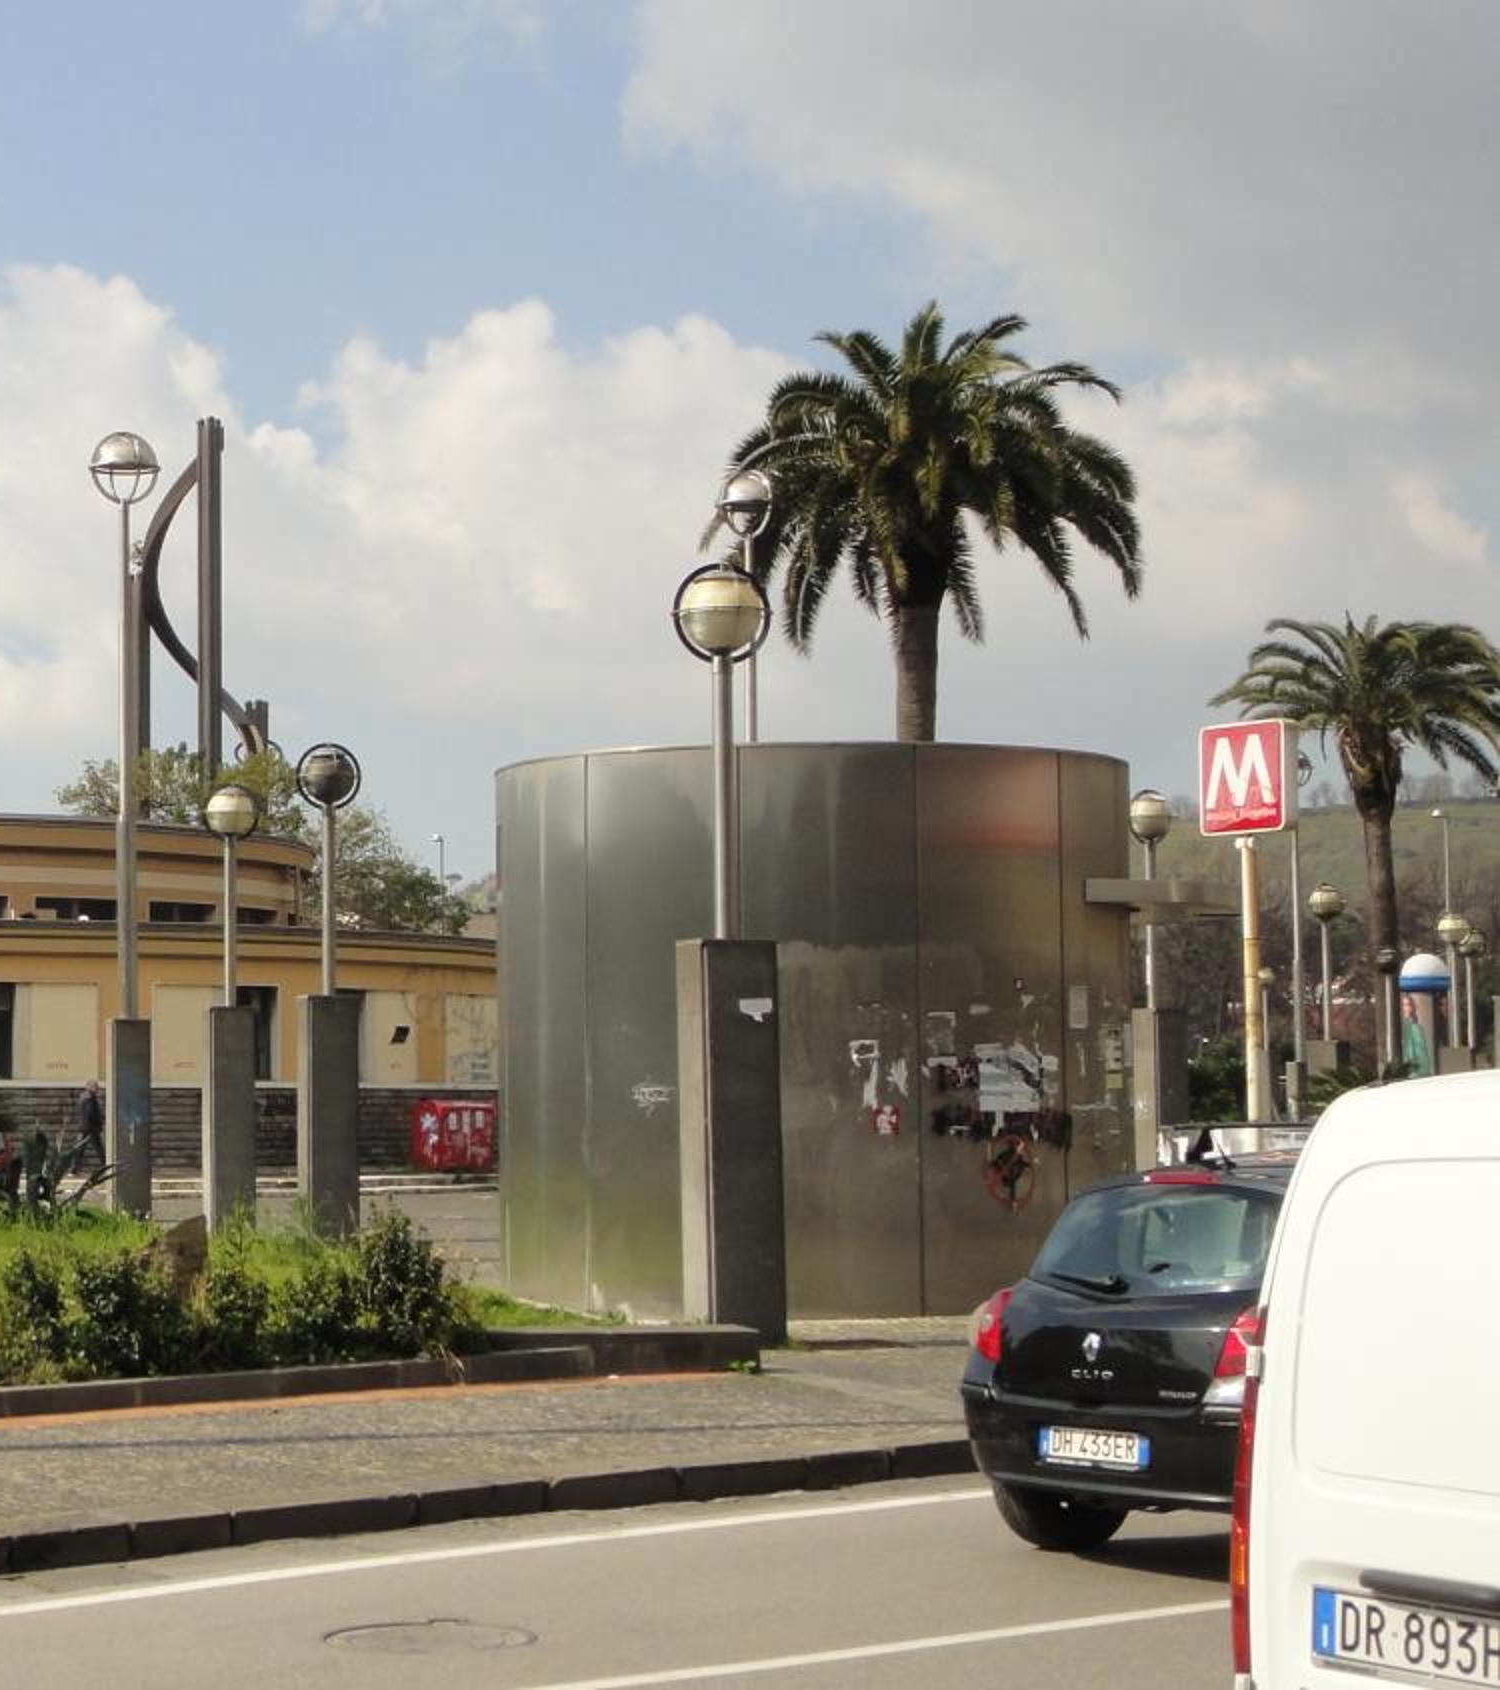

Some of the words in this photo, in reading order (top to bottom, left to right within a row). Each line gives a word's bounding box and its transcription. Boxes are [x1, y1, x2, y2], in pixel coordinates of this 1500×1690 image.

[1206, 733, 1276, 809] M
[1071, 1369, 1114, 1380] CLIO
[1052, 1428, 1073, 1453] DH
[1078, 1432, 1136, 1461] 433ER
[1341, 1601, 1385, 1658] DR
